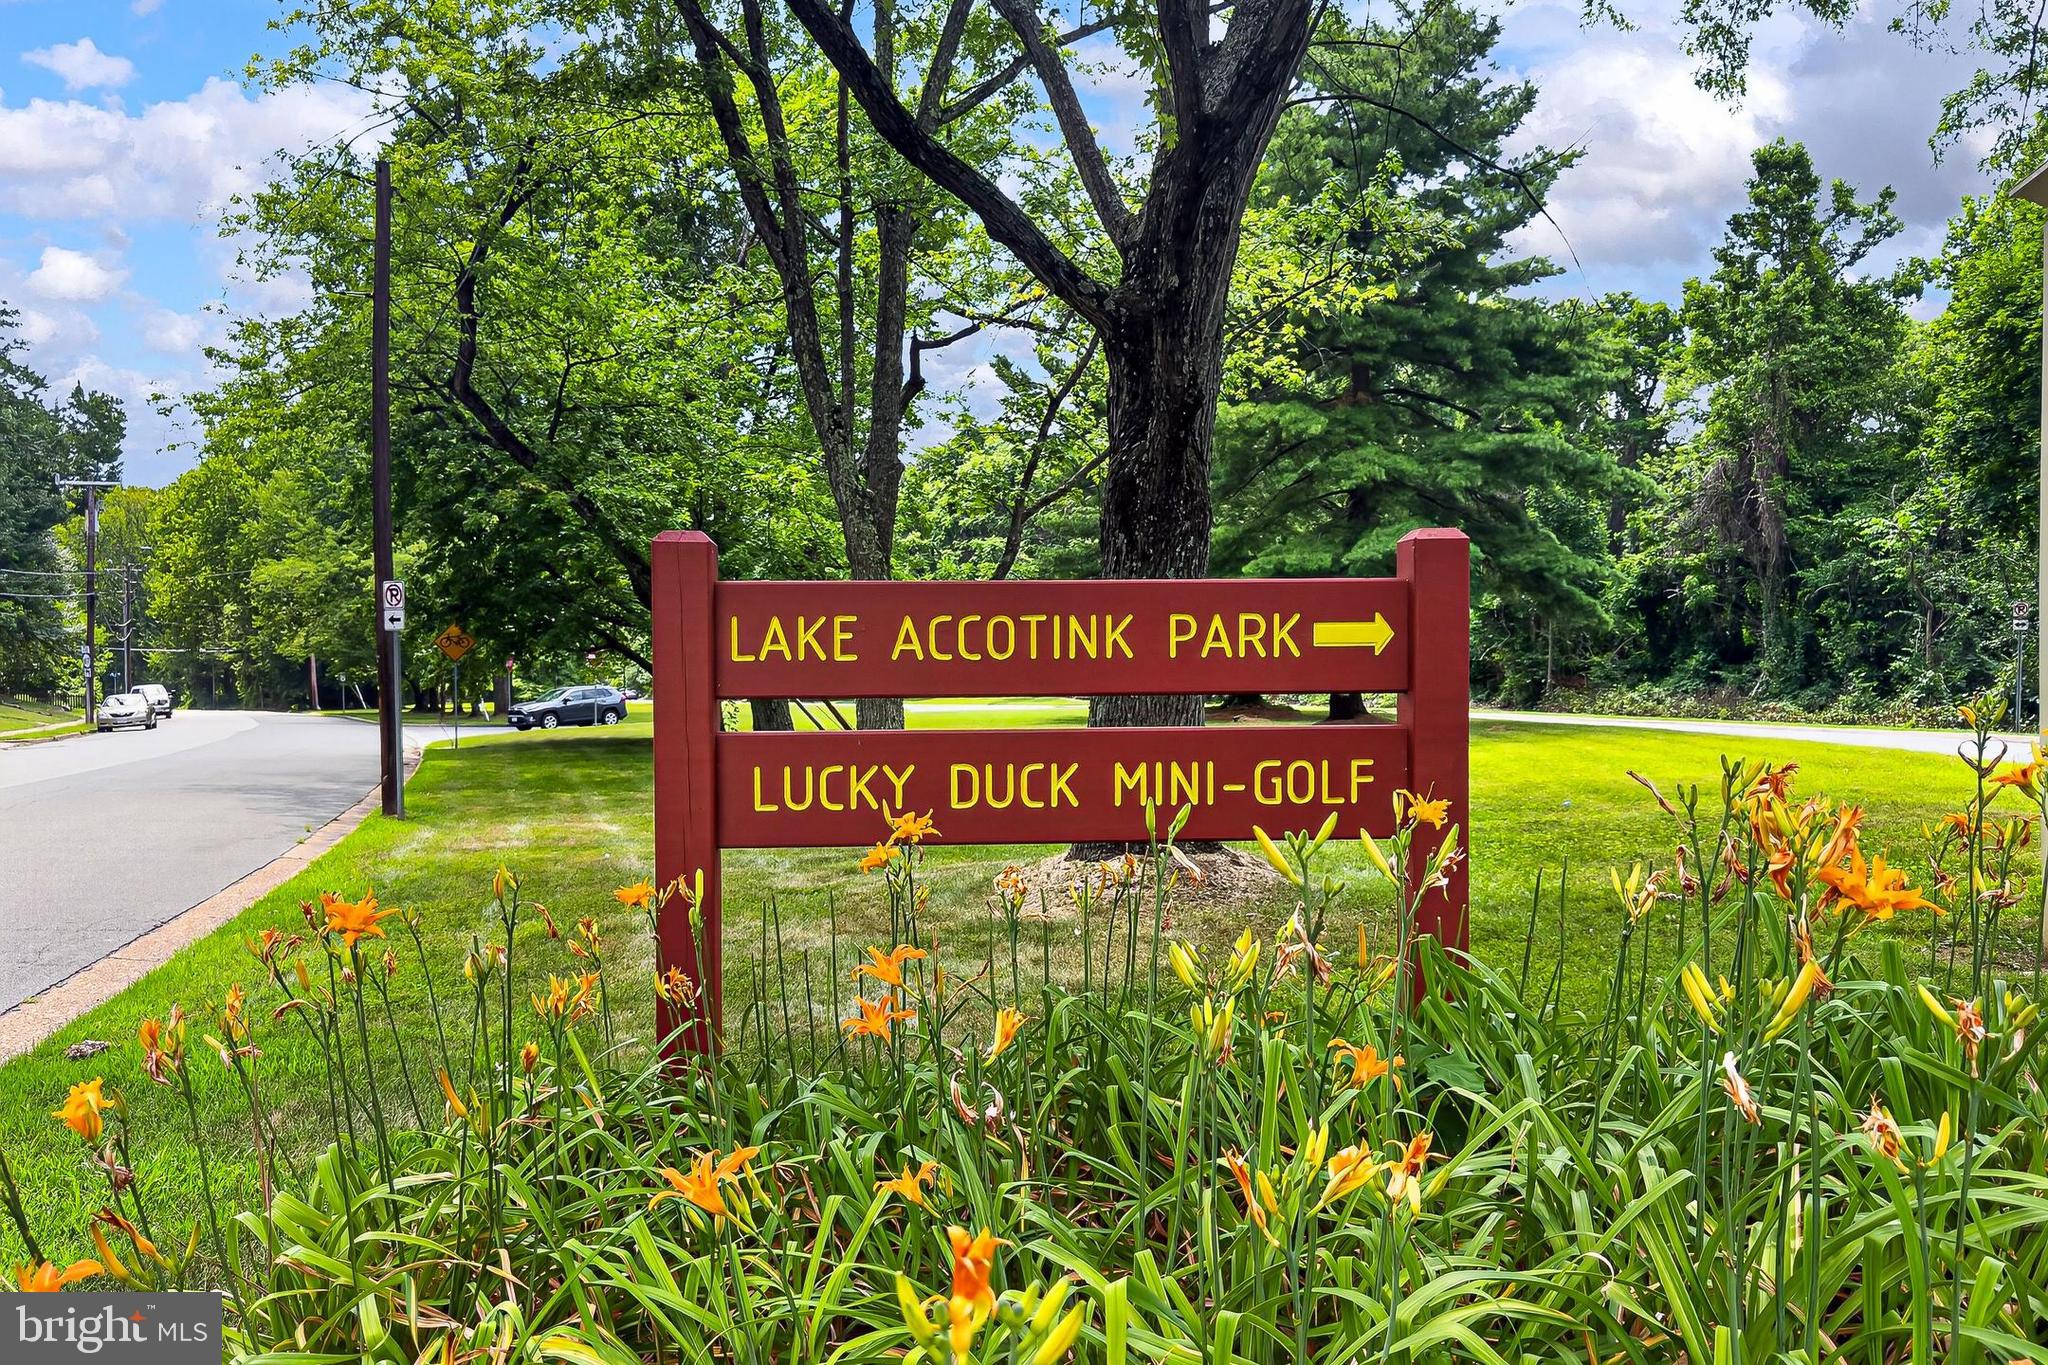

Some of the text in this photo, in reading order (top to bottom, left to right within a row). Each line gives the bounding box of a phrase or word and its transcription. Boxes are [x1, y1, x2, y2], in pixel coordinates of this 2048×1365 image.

[730, 612, 1301, 663] LAKE ACCOTINK PARK
[753, 758, 1375, 813] LUCKY DUCK MINI-GOLF
